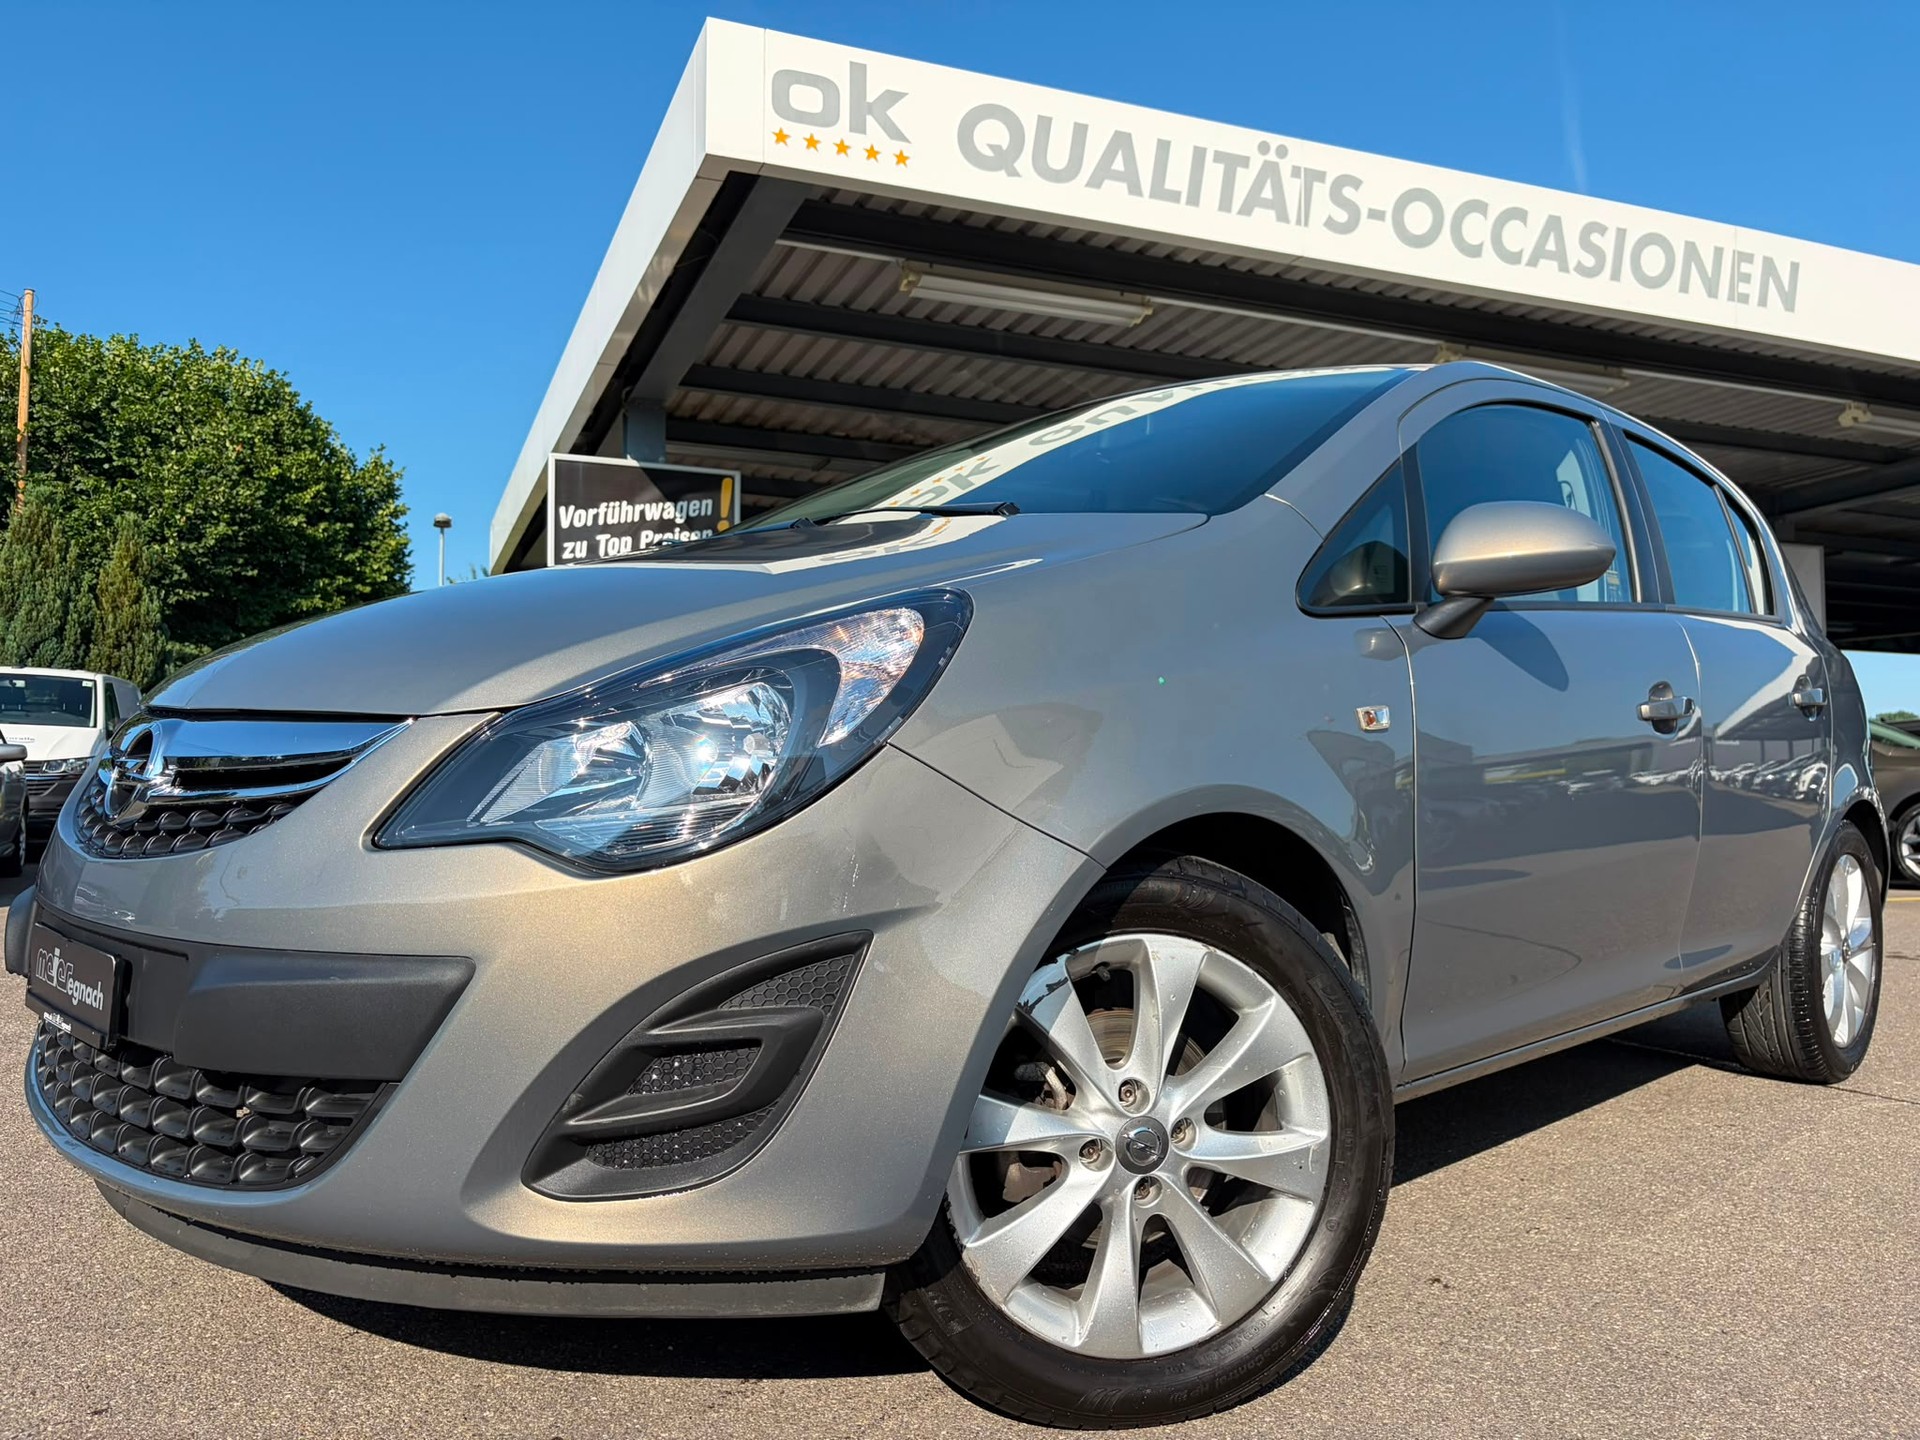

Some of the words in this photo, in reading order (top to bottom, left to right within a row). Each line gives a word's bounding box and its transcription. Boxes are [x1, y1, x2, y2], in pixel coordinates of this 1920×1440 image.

[771, 61, 911, 144] ok
[957, 102, 1800, 313] QUALITÄTS-OCCASIONEN
[559, 499, 713, 529] Vorführwagen
[562, 540, 588, 560] zu
